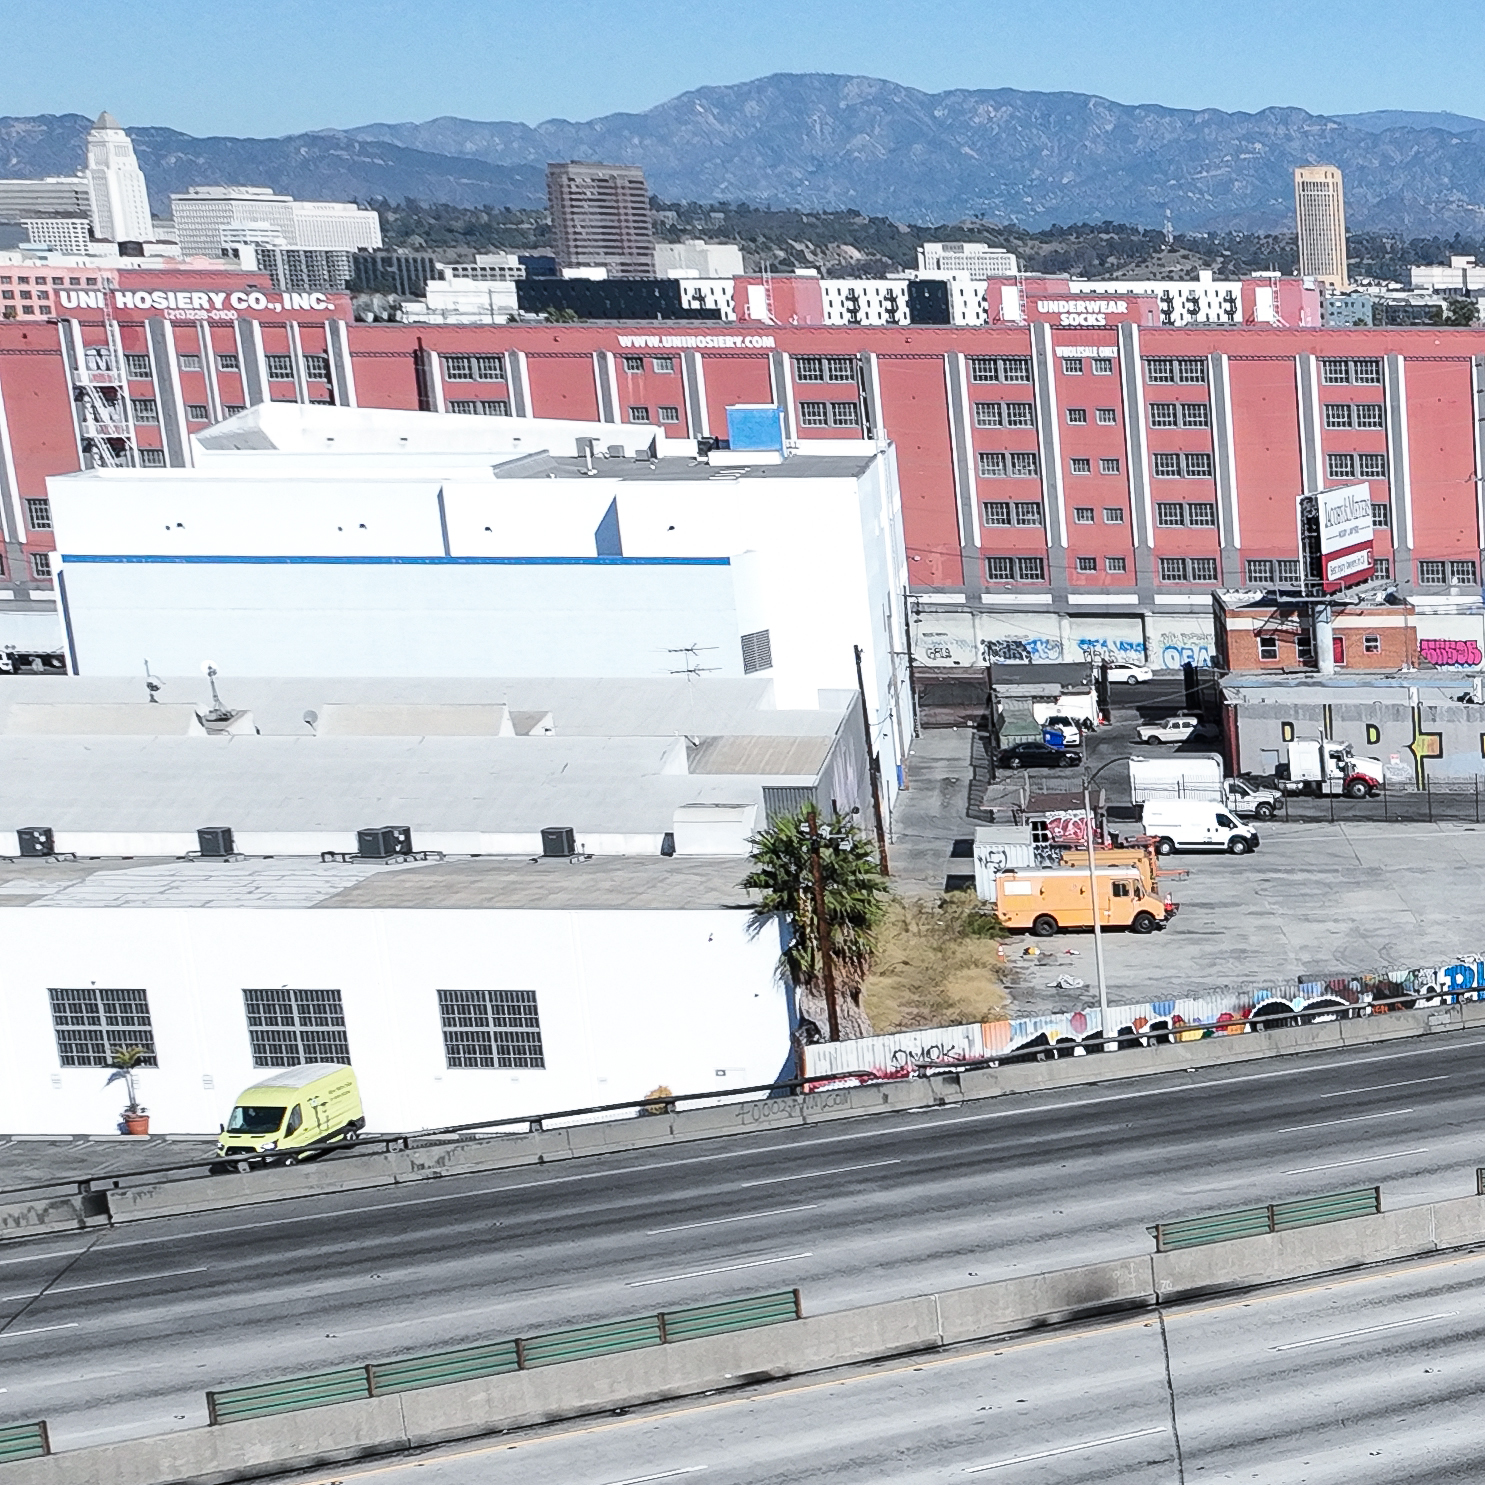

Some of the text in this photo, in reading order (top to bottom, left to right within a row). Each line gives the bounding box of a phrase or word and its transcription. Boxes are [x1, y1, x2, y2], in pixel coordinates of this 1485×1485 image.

[59, 290, 105, 310] UNI
[115, 291, 228, 311] HOSIERY
[1037, 300, 1128, 314] UNDERWEAR
[1060, 313, 1106, 326] SOCKS
[617, 335, 776, 348] WWW.UNIHOSIERY.COM
